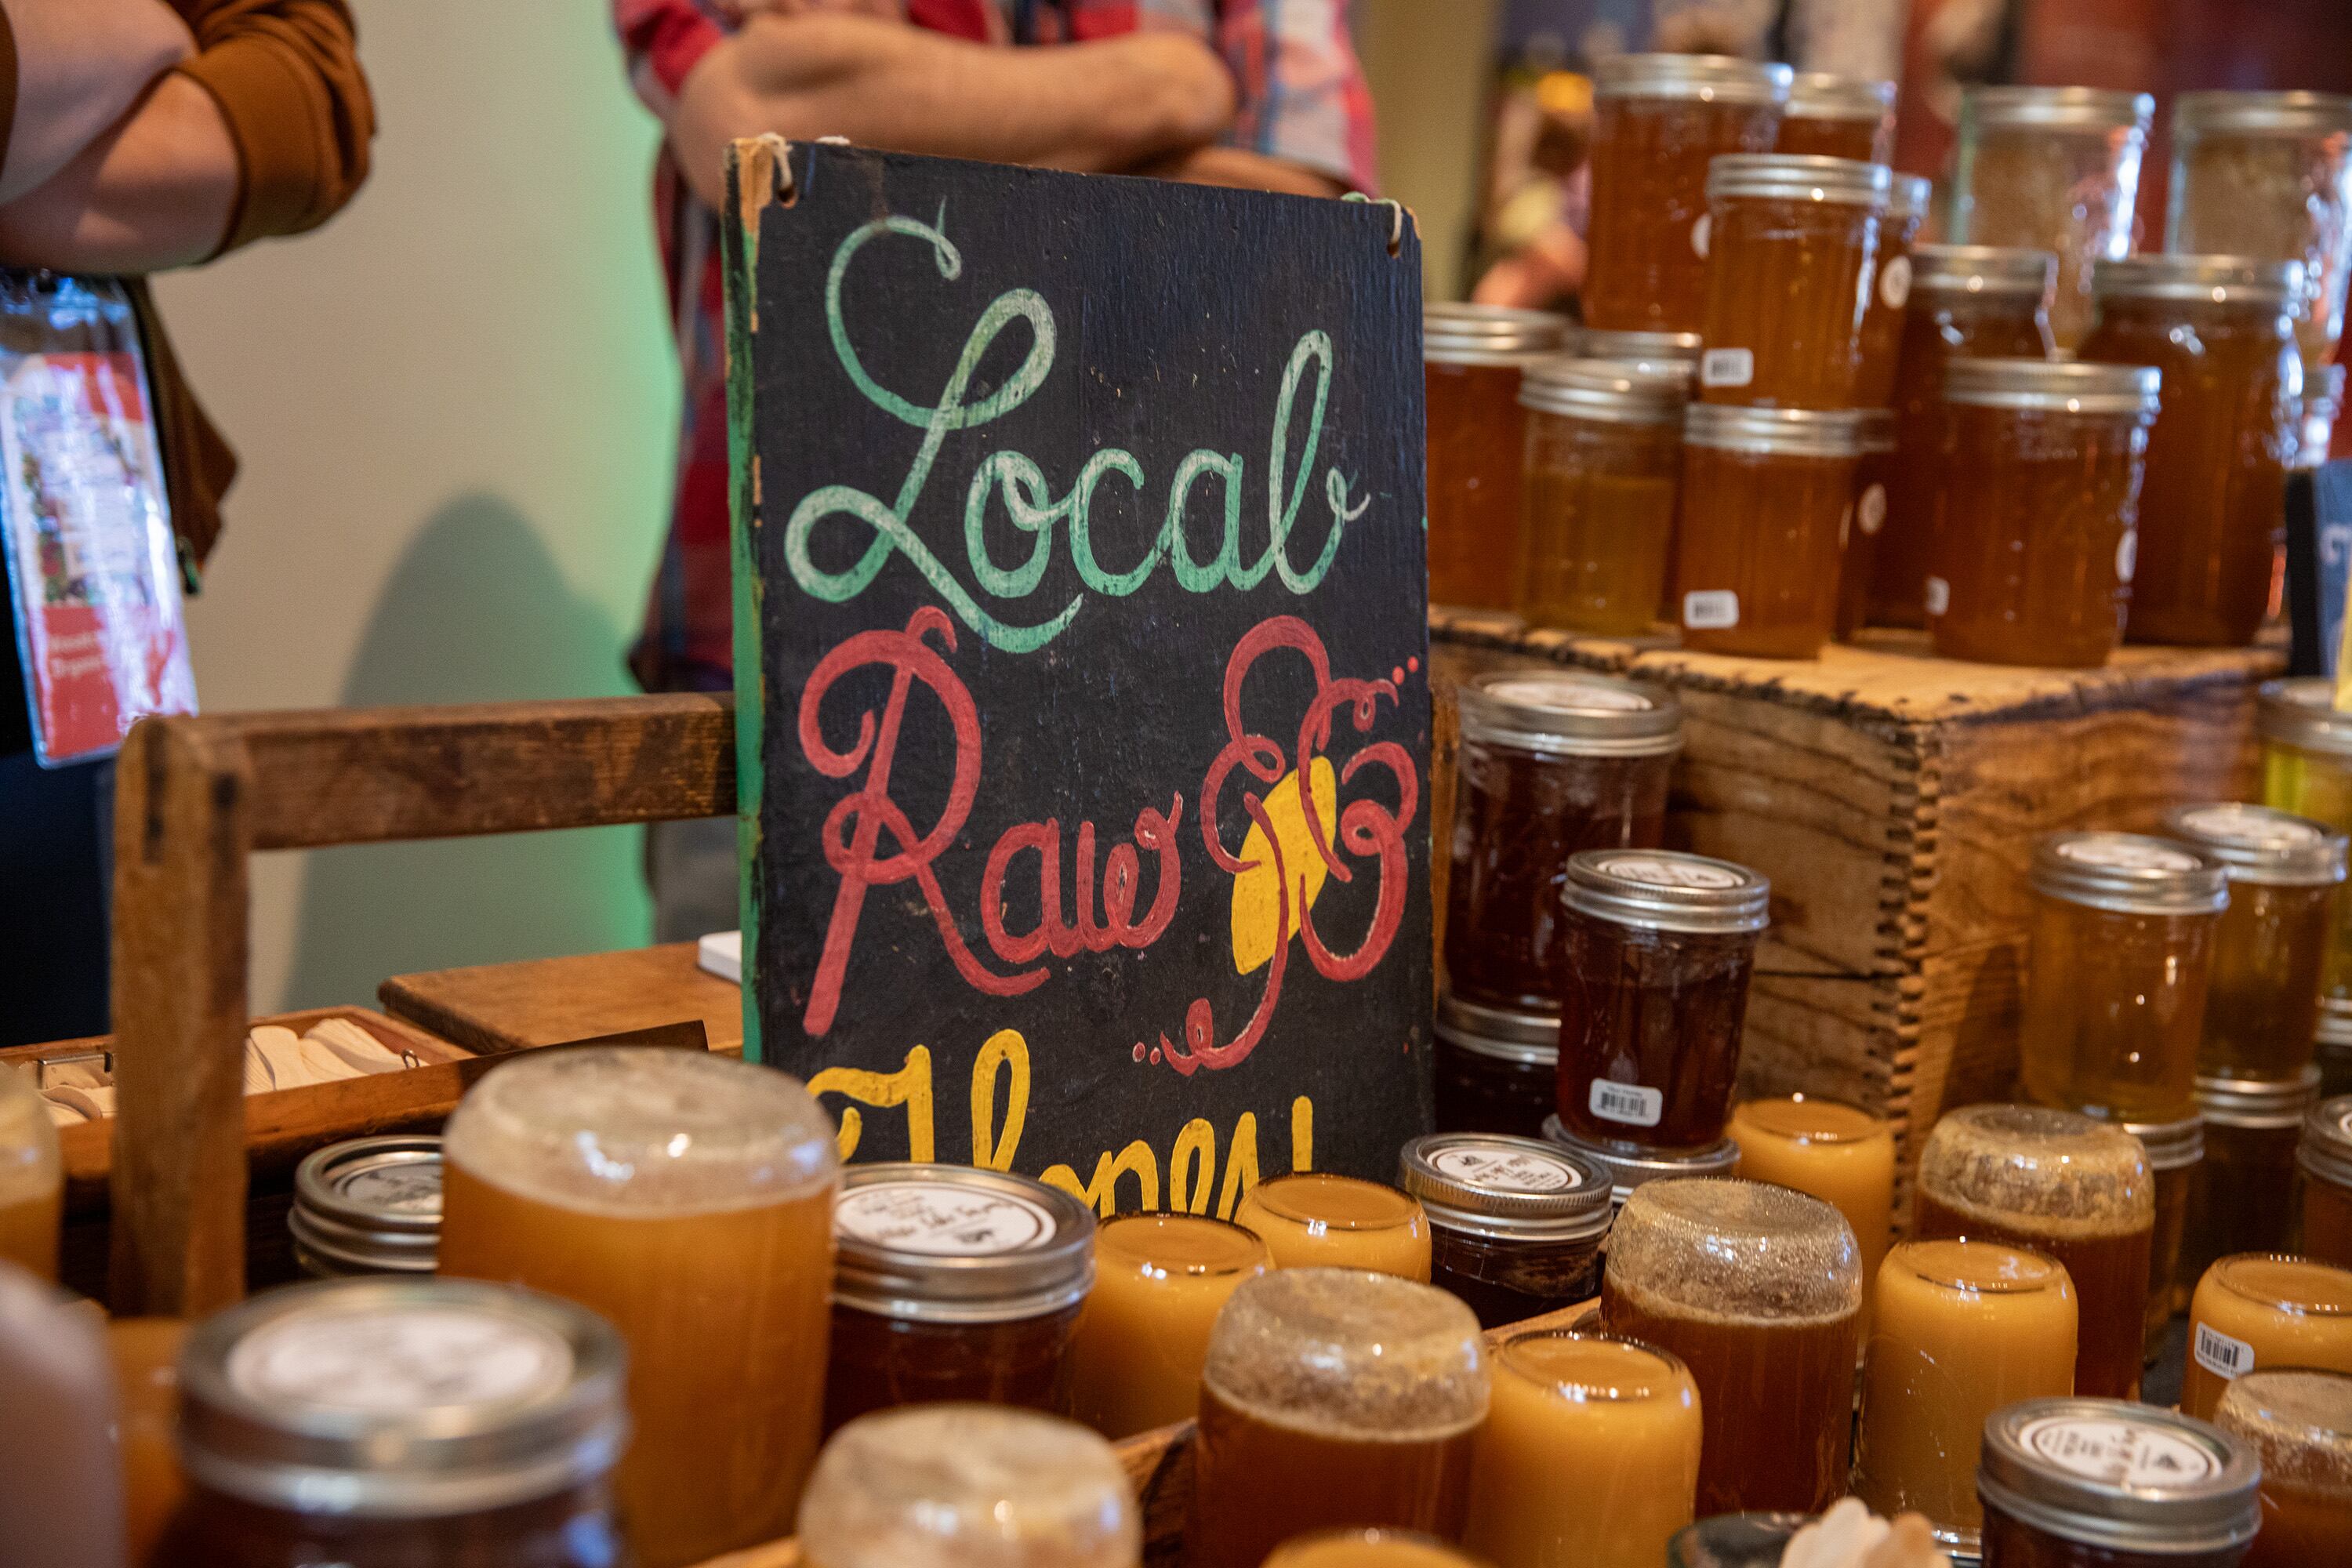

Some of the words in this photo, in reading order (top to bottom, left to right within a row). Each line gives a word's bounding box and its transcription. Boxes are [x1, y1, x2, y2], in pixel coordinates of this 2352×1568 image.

[786, 194, 1371, 654] Local
[798, 605, 1183, 1036] Raw
[807, 1028, 1314, 1220] Hne
